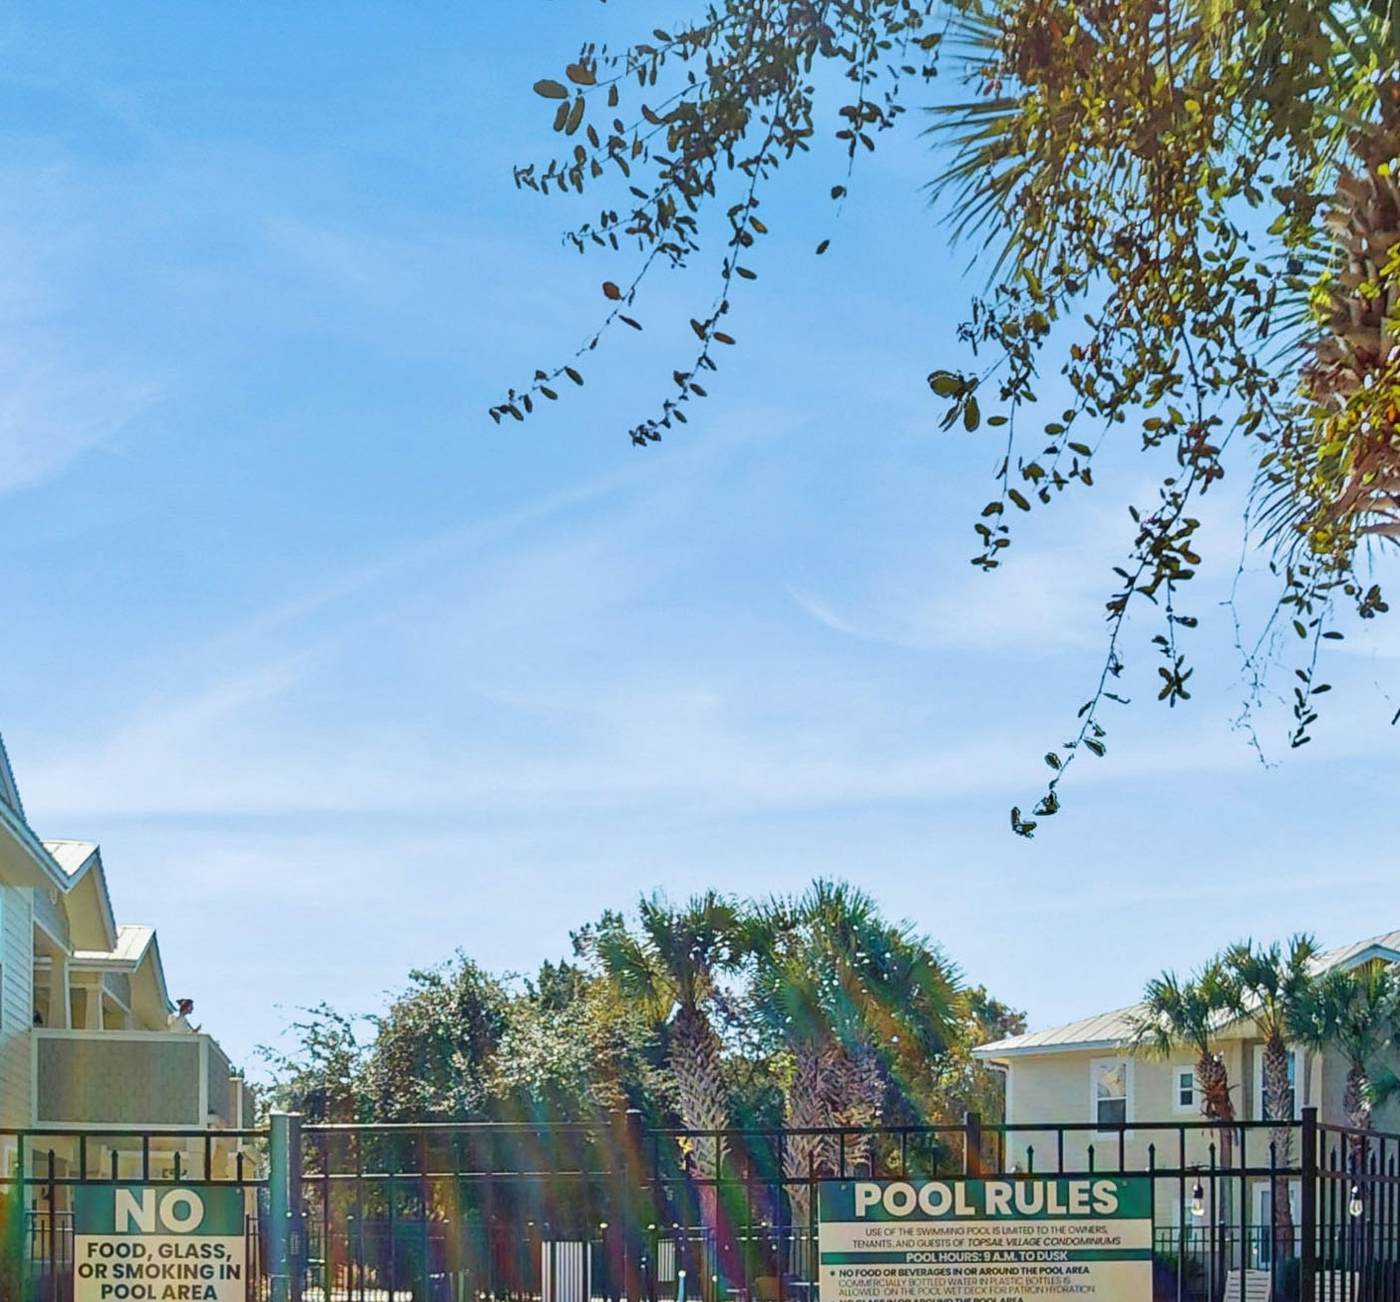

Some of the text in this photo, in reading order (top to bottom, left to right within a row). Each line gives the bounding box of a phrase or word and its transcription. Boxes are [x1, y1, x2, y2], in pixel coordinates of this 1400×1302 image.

[855, 1180, 1119, 1217] POOL RULES
[115, 1188, 204, 1233] NO
[865, 1228, 881, 1237] USE
[884, 1228, 896, 1237] OF
[900, 1228, 915, 1237] THE
[916, 1227, 965, 1237] SWIMMING
[966, 1227, 990, 1236] POOL
[993, 1226, 1001, 1236] IS
[1002, 1226, 1034, 1236] LIMITED
[1037, 1226, 1048, 1236] TO
[1050, 1225, 1066, 1236] THE
[896, 1239, 915, 1249] AND
[917, 1239, 951, 1248] GUESTS
[953, 1239, 964, 1248] OF
[968, 1238, 1003, 1248] TOPSAIL
[1006, 1238, 1041, 1247] VILLAGE
[1043, 1237, 1121, 1246] CONDOMINIUMS
[87, 1242, 232, 1262] FOOD, GLASS,
[906, 1250, 1068, 1263] POOL HOURS: 9 A.M. TO DUSK
[78, 1263, 241, 1280] OR SMOKING IN
[839, 1266, 1090, 1278] NO FOOD OR BEVERAGES IN OR AROUND THE POOL AREA
[839, 1276, 1071, 1288] COMMERCIALLY BOTTLED WATER IN PLASTIC BOTTLES IS
[101, 1284, 218, 1300] POOL AREA
[839, 1288, 880, 1297] ALLOWED
[884, 1288, 898, 1297] ON
[900, 1287, 917, 1296] THE
[918, 1287, 941, 1296] POOL
[944, 1287, 963, 1296] WET
[990, 1286, 1007, 1295] FOR
[1008, 1286, 1044, 1295] PATRON
[1046, 1285, 1095, 1294] HYDRATION
